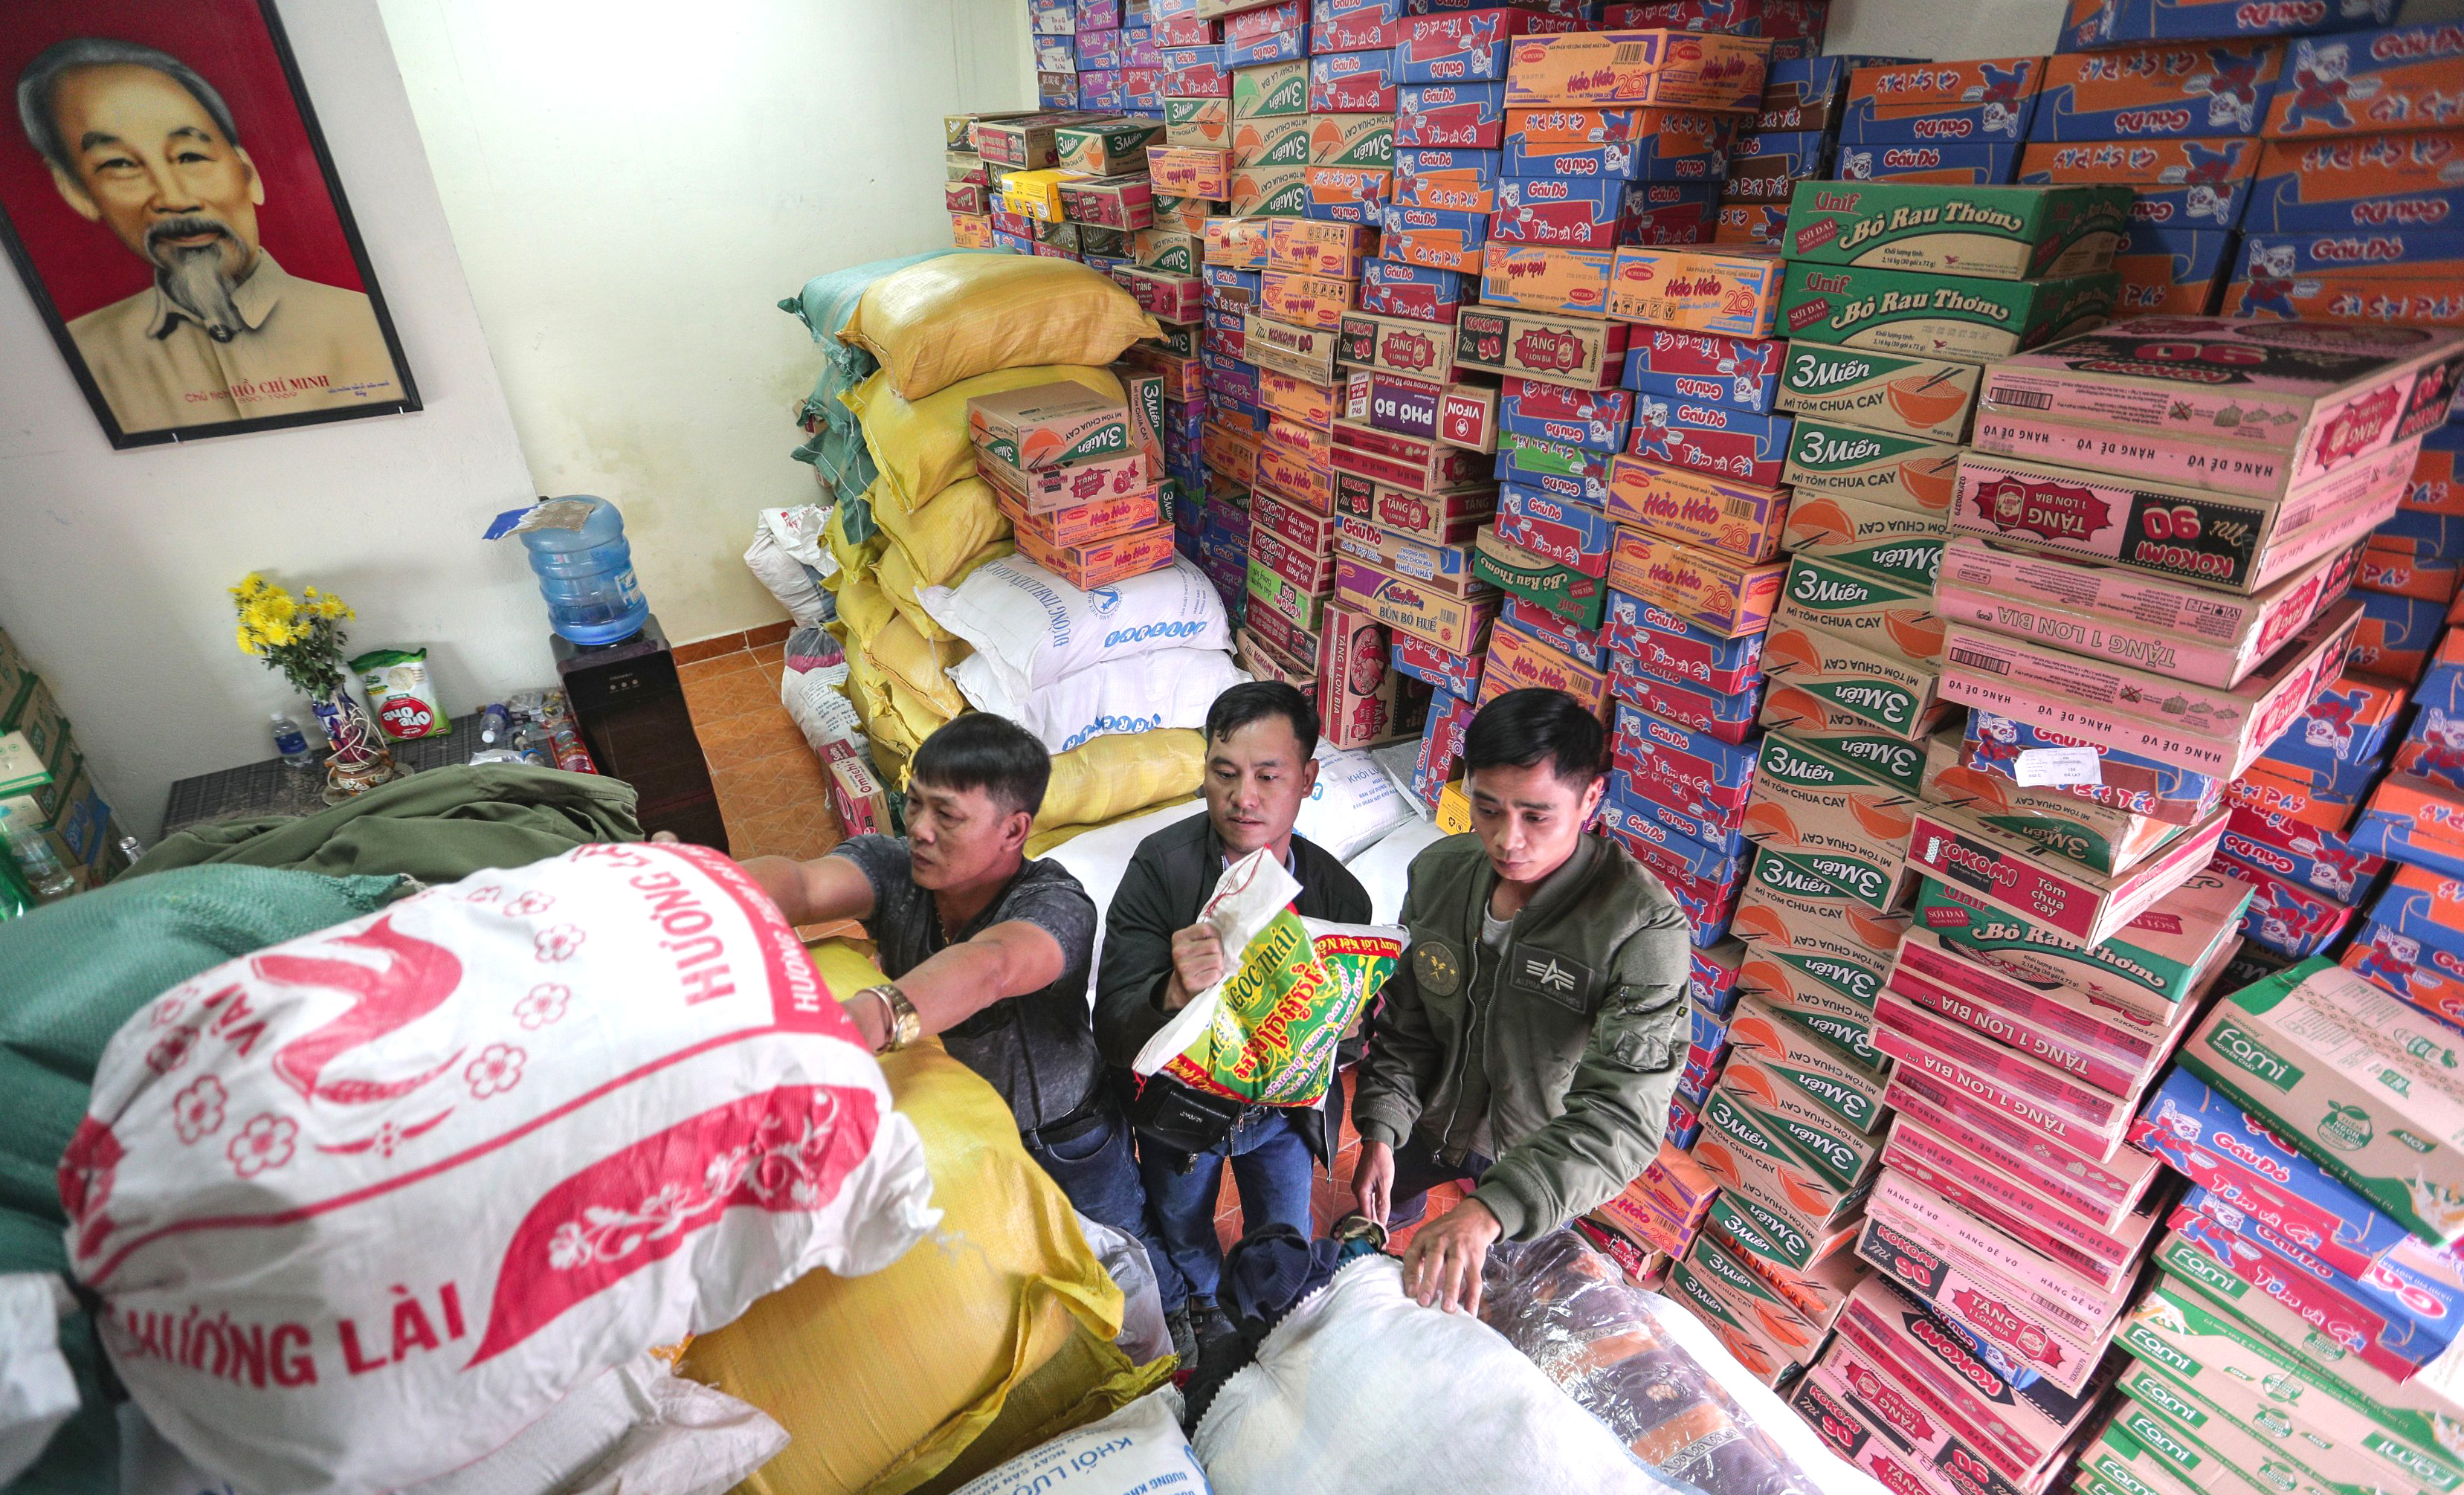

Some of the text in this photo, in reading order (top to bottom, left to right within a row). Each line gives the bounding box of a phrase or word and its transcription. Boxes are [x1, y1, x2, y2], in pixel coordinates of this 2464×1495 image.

[1338, 90, 1380, 109] Tôm và Gà
[1428, 125, 1476, 144] Tôm và Gà
[1814, 191, 1861, 211] Unif
[1890, 206, 1940, 230] Rau
[1944, 200, 2022, 230] Thơm
[1533, 222, 1557, 239] Tôm
[1572, 222, 1591, 243] Gà
[1665, 275, 1722, 297] Hảo Hảo
[1805, 272, 1853, 294] Unif
[1879, 292, 1929, 314] Rau
[1933, 288, 2010, 322] Thơm
[1344, 322, 1373, 336] KOKOMI
[1465, 315, 1503, 332] KOKOMI
[1390, 336, 1412, 353] TẶNG
[1526, 335, 1555, 352] TẶNG
[1529, 353, 1542, 362] LON
[1543, 355, 1552, 364] BIA
[231, 378, 256, 398] HỒ
[259, 377, 285, 393] CHÍ
[290, 375, 330, 390] MINH
[1448, 404, 1480, 419] VIFON
[1784, 393, 1885, 411] MÌ TÔM CHUA CAY
[1065, 429, 1080, 442] CAY
[1081, 419, 1100, 430] CHUA
[2018, 431, 2049, 443] HÀNG
[1682, 444, 1753, 477] Tôm và Gà
[1791, 471, 1896, 488] MÌ TÔM CHUA CAY
[1386, 497, 1408, 515] TẶNG
[1642, 491, 1720, 525] Hảo Hảo
[2035, 492, 2051, 502] BIA
[2051, 494, 2077, 508] LON
[2028, 507, 2086, 535] TẶNG
[2143, 505, 2200, 540] 90
[2136, 541, 2235, 577] KOKOMI
[1648, 563, 1702, 590] Hảo Hảo
[1997, 606, 2034, 630] BIA
[2038, 620, 2085, 643] LON
[2108, 631, 2176, 670] TẶNG
[1823, 659, 1919, 686] MÌ TÔM CHUA CAY
[383, 706, 413, 721] One
[399, 711, 431, 726] One
[846, 763, 872, 793] Omachi
[1760, 777, 1845, 807] MÌ TÔM CHUA CAY
[2036, 876, 2068, 899] Tôm
[2031, 888, 2065, 911] chua
[2033, 898, 2060, 918] cay
[1257, 924, 1298, 975] THÁI
[1939, 994, 1969, 1021] BIA
[1973, 1013, 2015, 1043] LON
[2032, 1036, 2089, 1075] TẶNG
[2216, 1027, 2289, 1080] Fami
[1877, 1226, 1938, 1271] KOKOMI
[2175, 1245, 2237, 1294] Fami
[1969, 1295, 2019, 1331] TẶNG
[338, 1281, 465, 1376] LÀI
[1911, 1320, 2002, 1395] KOKOMI
[2129, 1326, 2193, 1372] Fami
[1809, 1385, 1861, 1435] KOKOMI
